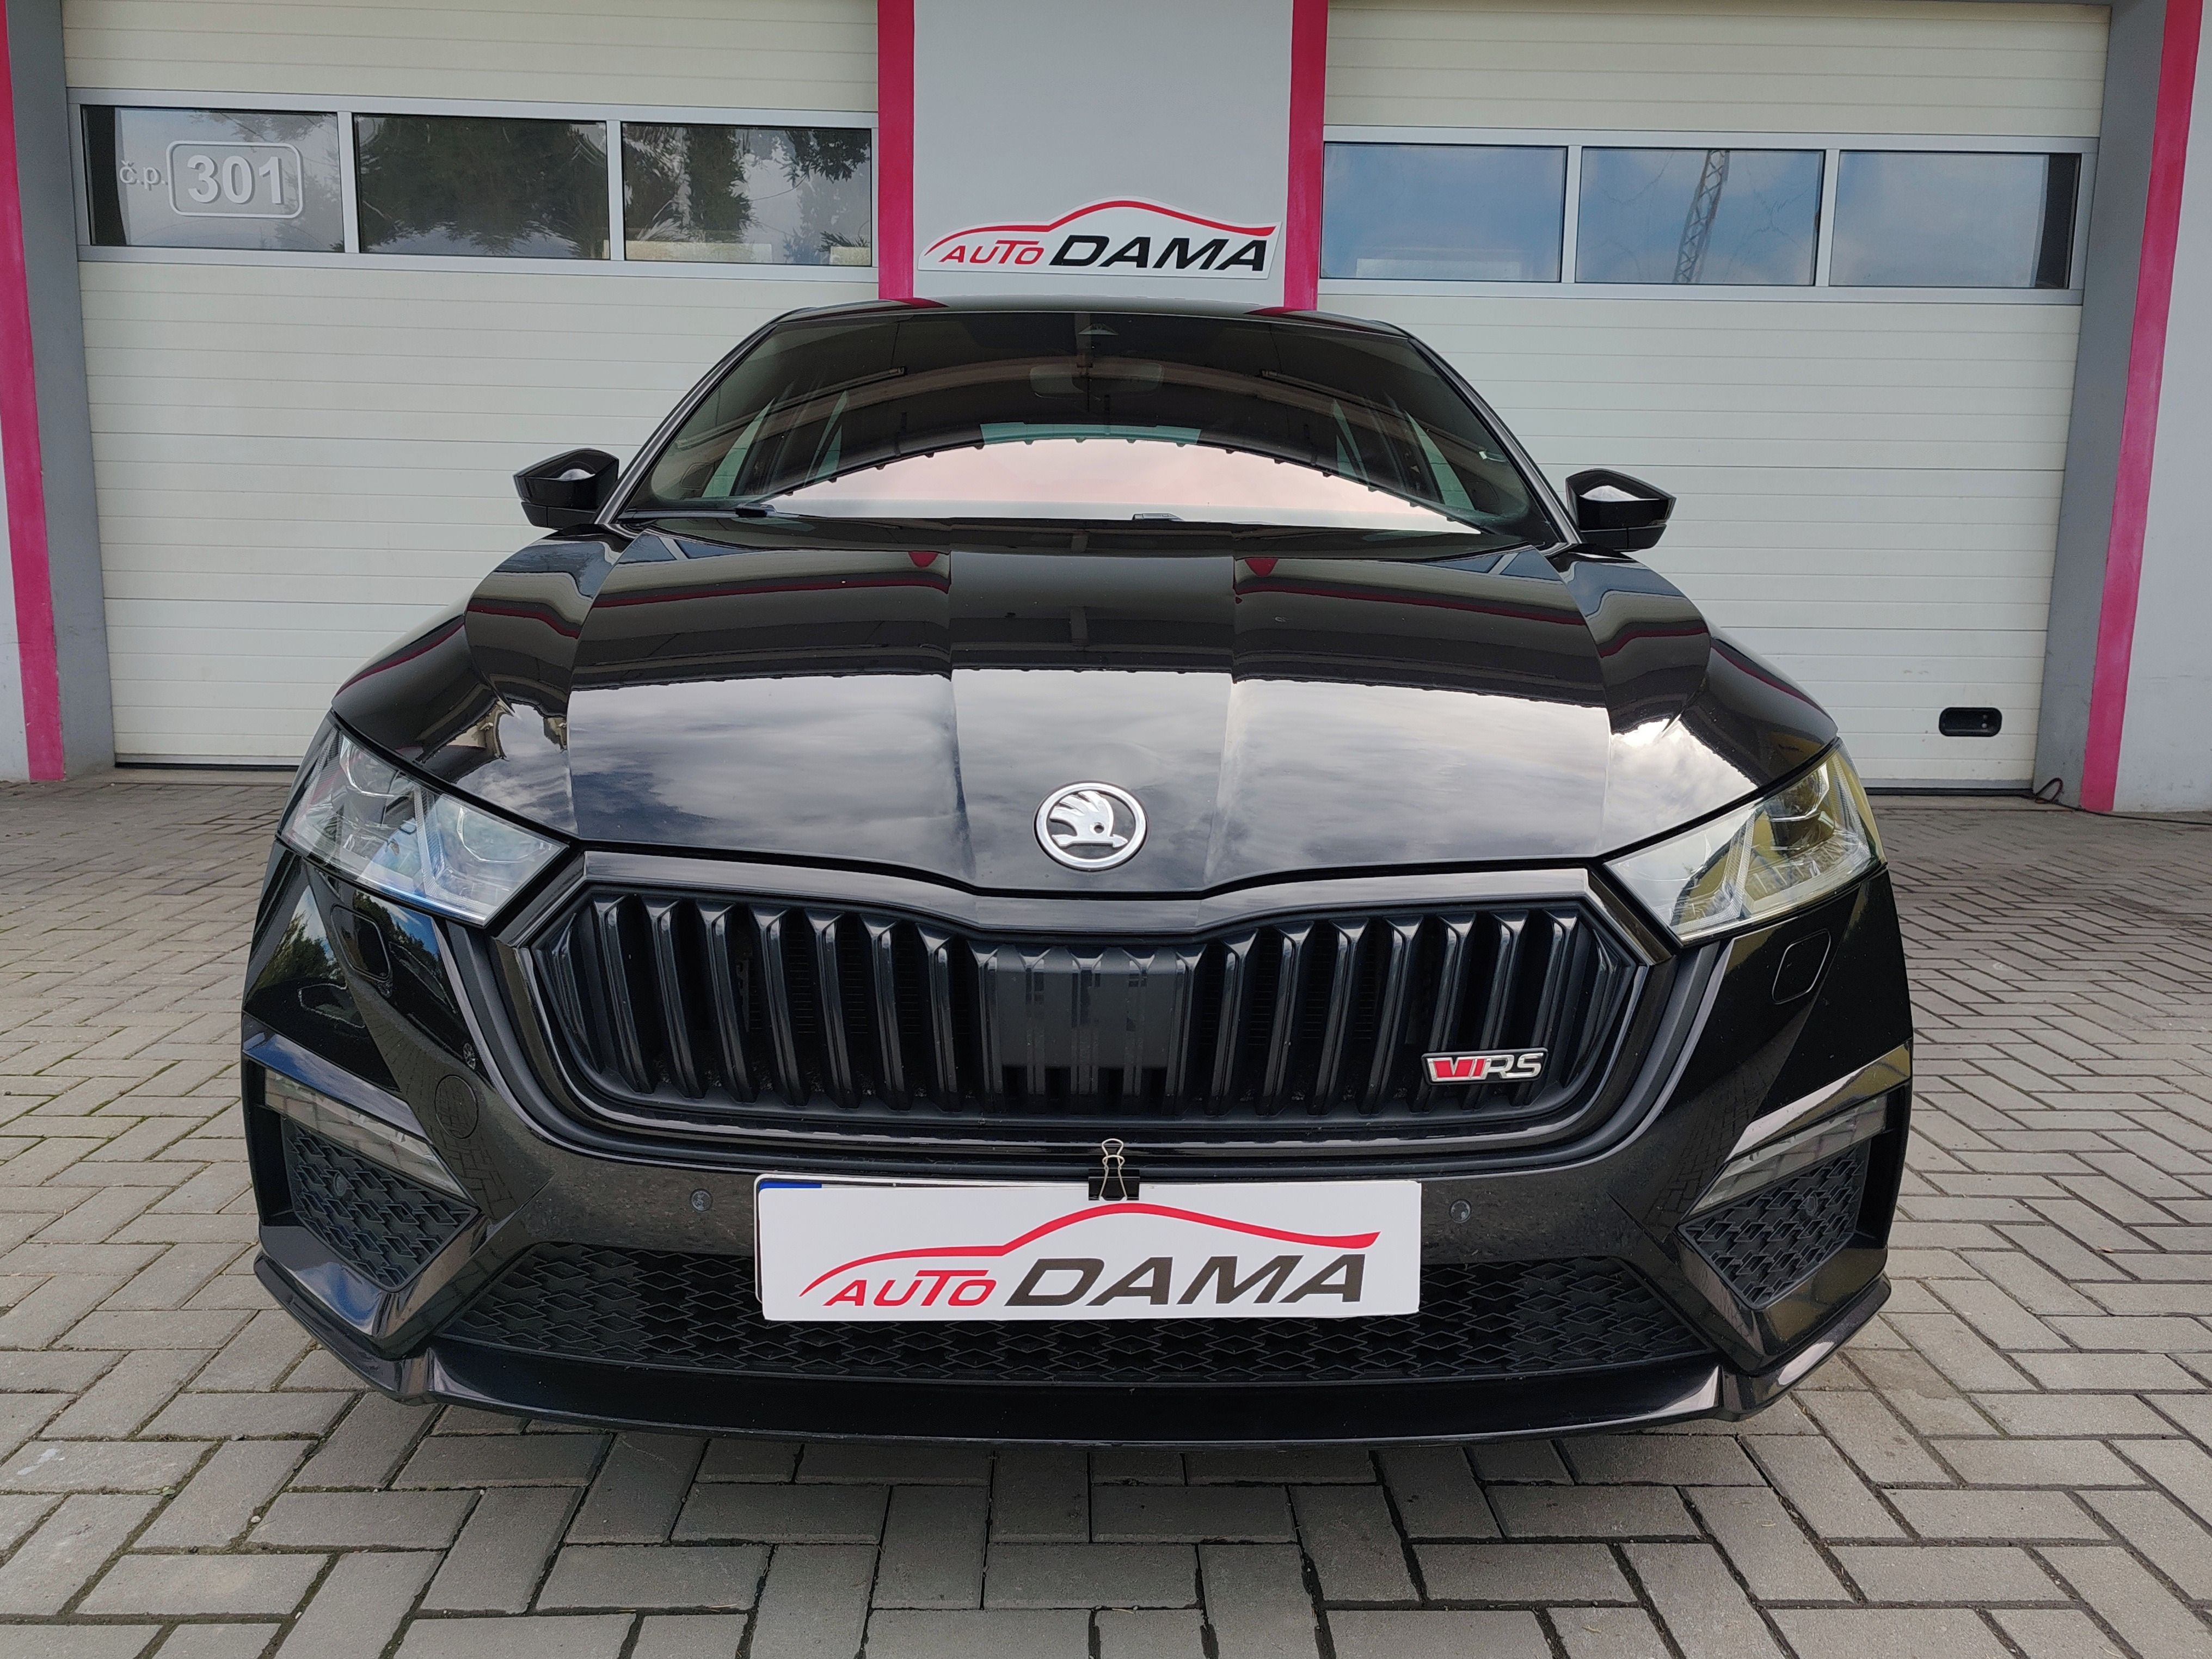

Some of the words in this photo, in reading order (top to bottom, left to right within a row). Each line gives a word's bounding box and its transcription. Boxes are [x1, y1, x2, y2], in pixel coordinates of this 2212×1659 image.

[187, 155, 282, 204] 301
[938, 239, 1044, 265] AUTO
[1048, 235, 1268, 272] DAMA
[822, 1269, 997, 1306] AUTO
[1004, 1254, 1366, 1306] DAMA
